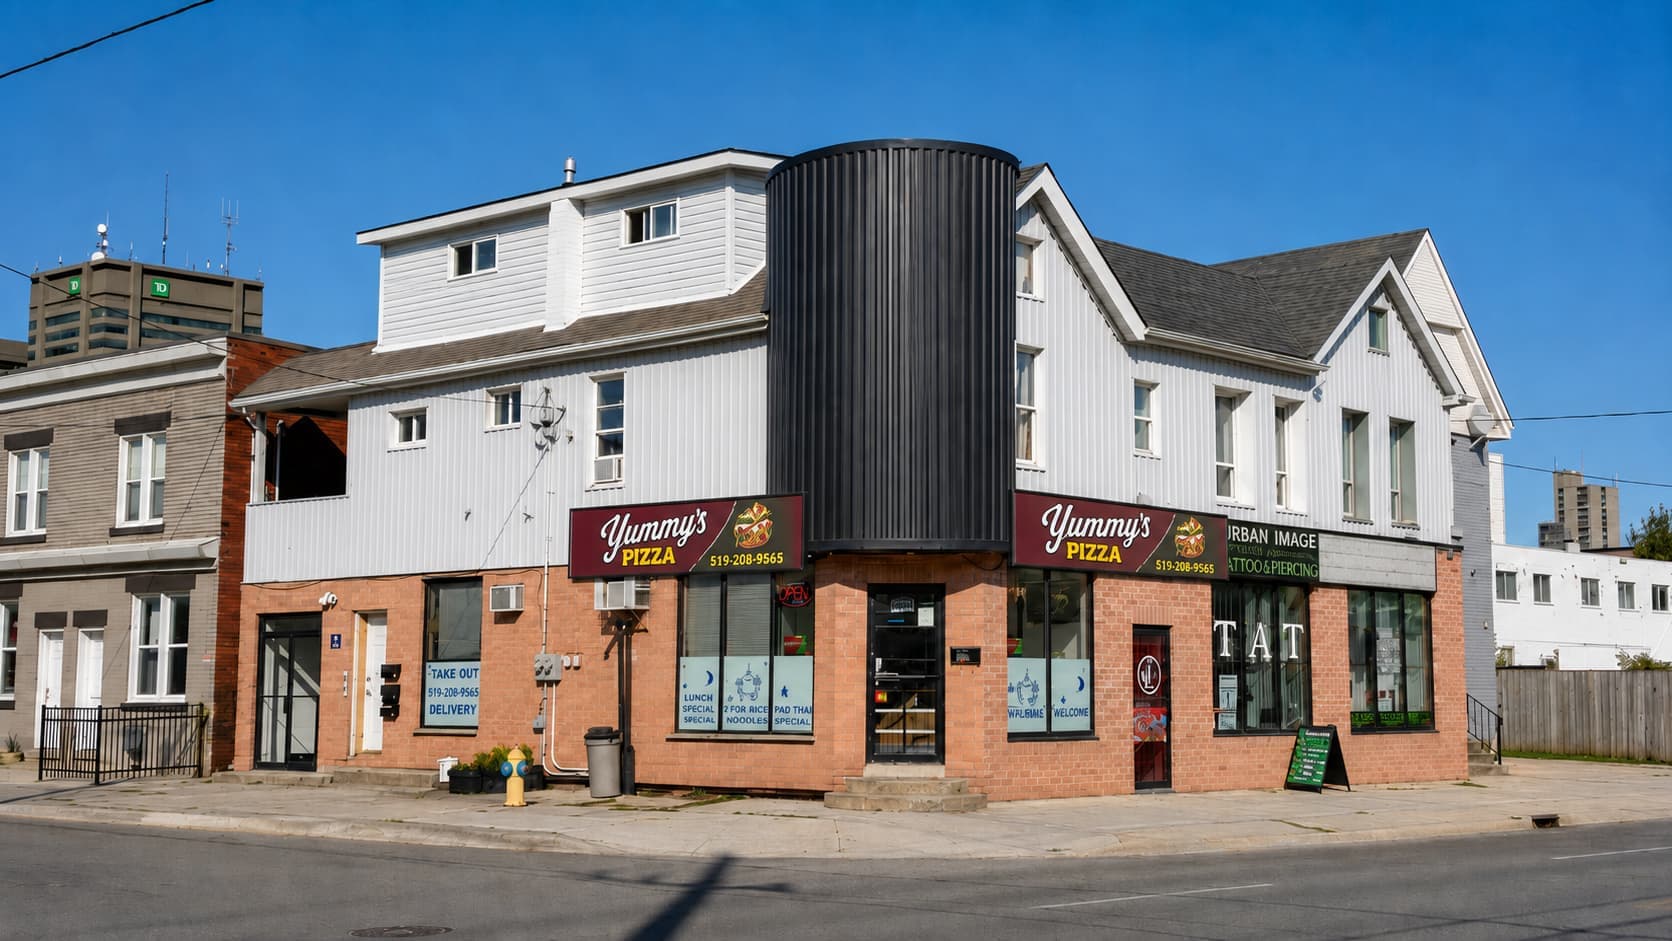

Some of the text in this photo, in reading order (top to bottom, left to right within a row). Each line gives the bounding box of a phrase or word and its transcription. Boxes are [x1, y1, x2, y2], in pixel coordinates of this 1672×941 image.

[154, 282, 167, 293] TD
[1042, 504, 1151, 553] Yummy's
[601, 508, 707, 563] Yummy's
[1274, 529, 1317, 549] IMAGE
[622, 547, 676, 566] PIZZA
[1066, 541, 1122, 563] PIZZA
[710, 552, 784, 567] 519-208-9565
[1155, 560, 1215, 574] 519-208-9565
[431, 668, 480, 679] TAKE OUT
[428, 687, 479, 698] 519-208-9565
[684, 694, 713, 702] LUNCH
[429, 704, 477, 715] DELIVERY
[682, 705, 714, 713] SPECIAL
[730, 705, 746, 713] FOR
[774, 705, 791, 714] PAD
[1054, 708, 1089, 717] WELCOME
[683, 716, 716, 724] SPECIAL
[774, 717, 811, 726] SPECIAL
